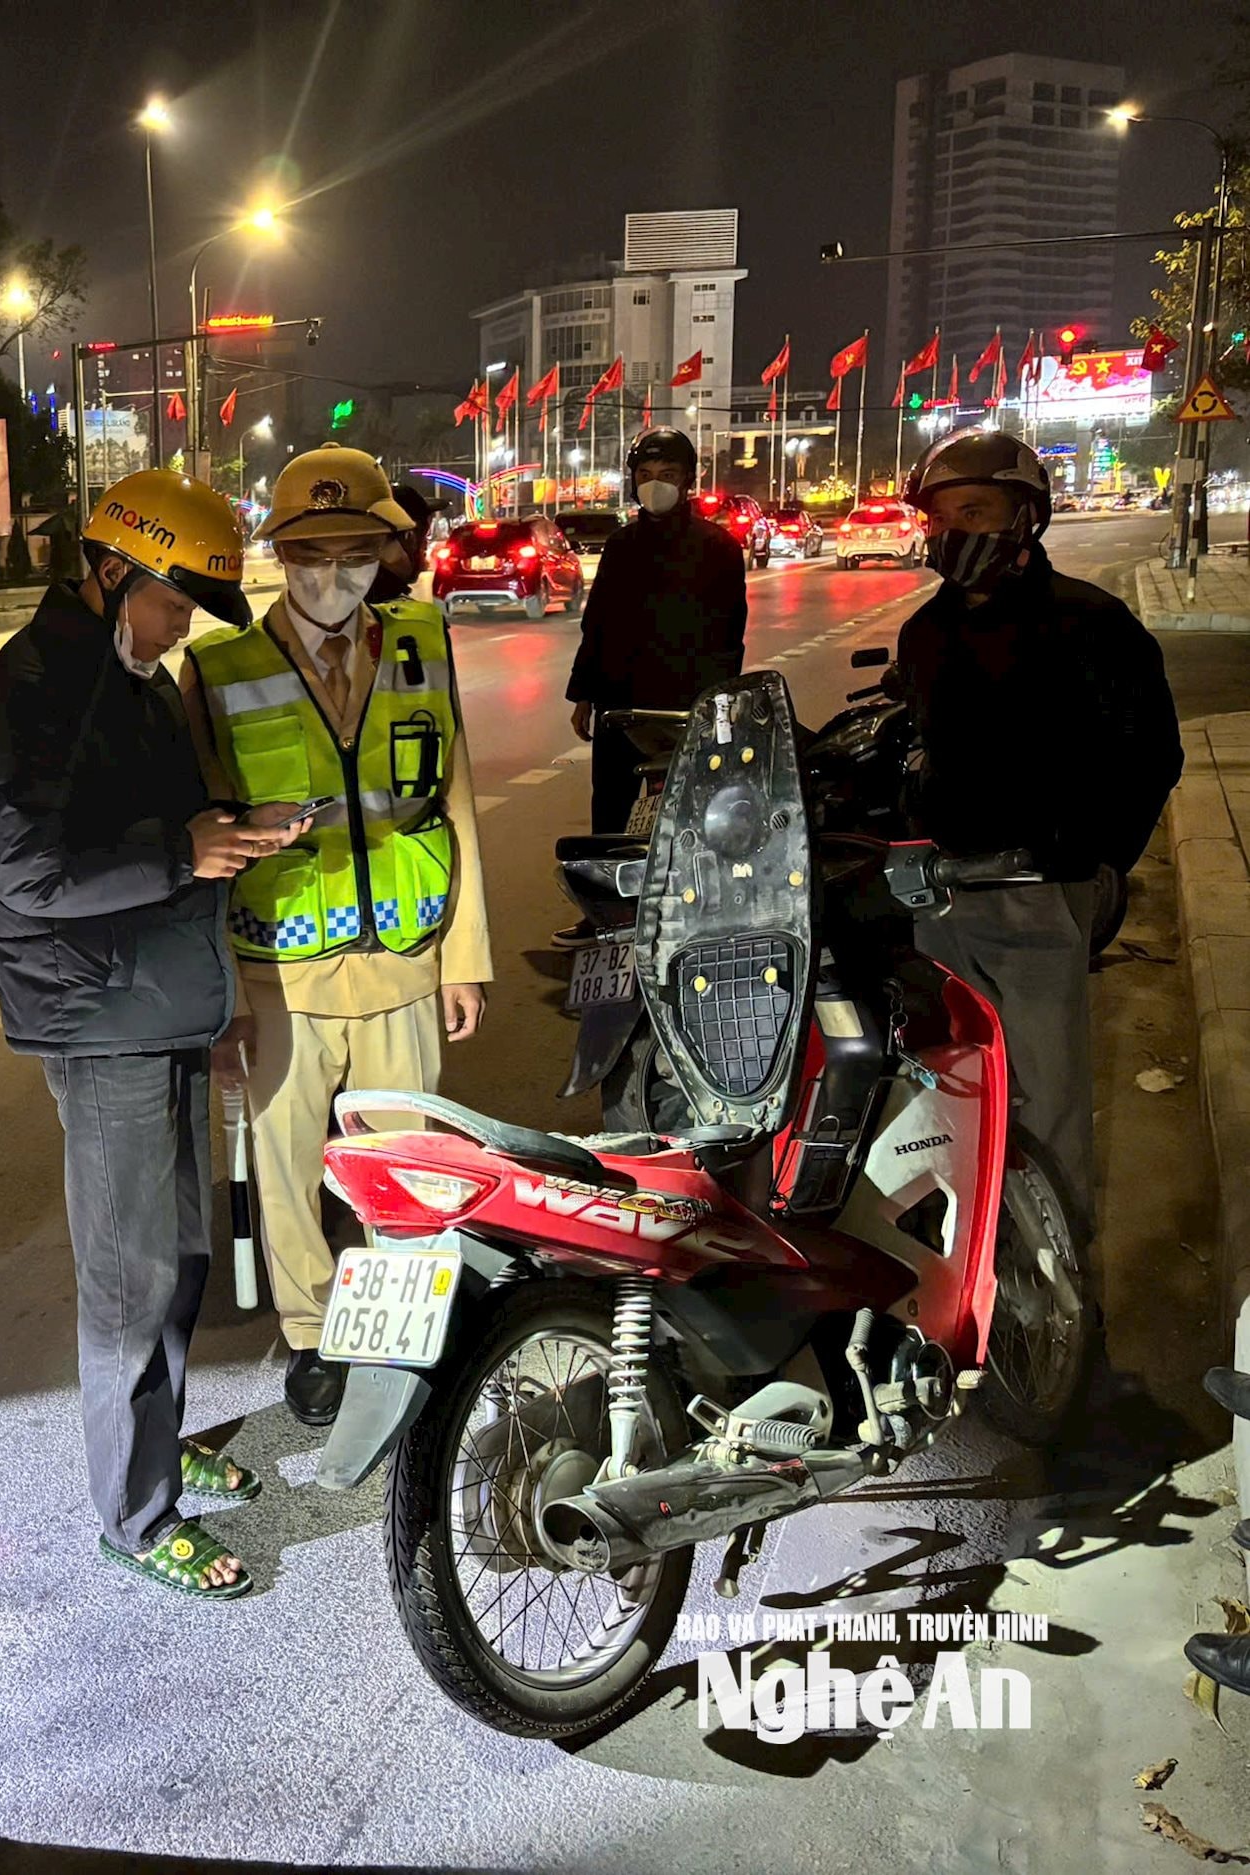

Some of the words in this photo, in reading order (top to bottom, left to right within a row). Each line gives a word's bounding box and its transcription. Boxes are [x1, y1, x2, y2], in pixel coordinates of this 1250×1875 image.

[105, 501, 177, 549] maxim
[573, 972, 631, 1004] 188.37
[894, 1134, 953, 1156] HONDA
[351, 1258, 438, 1304] 38-H1
[330, 1307, 436, 1357] 058.41
